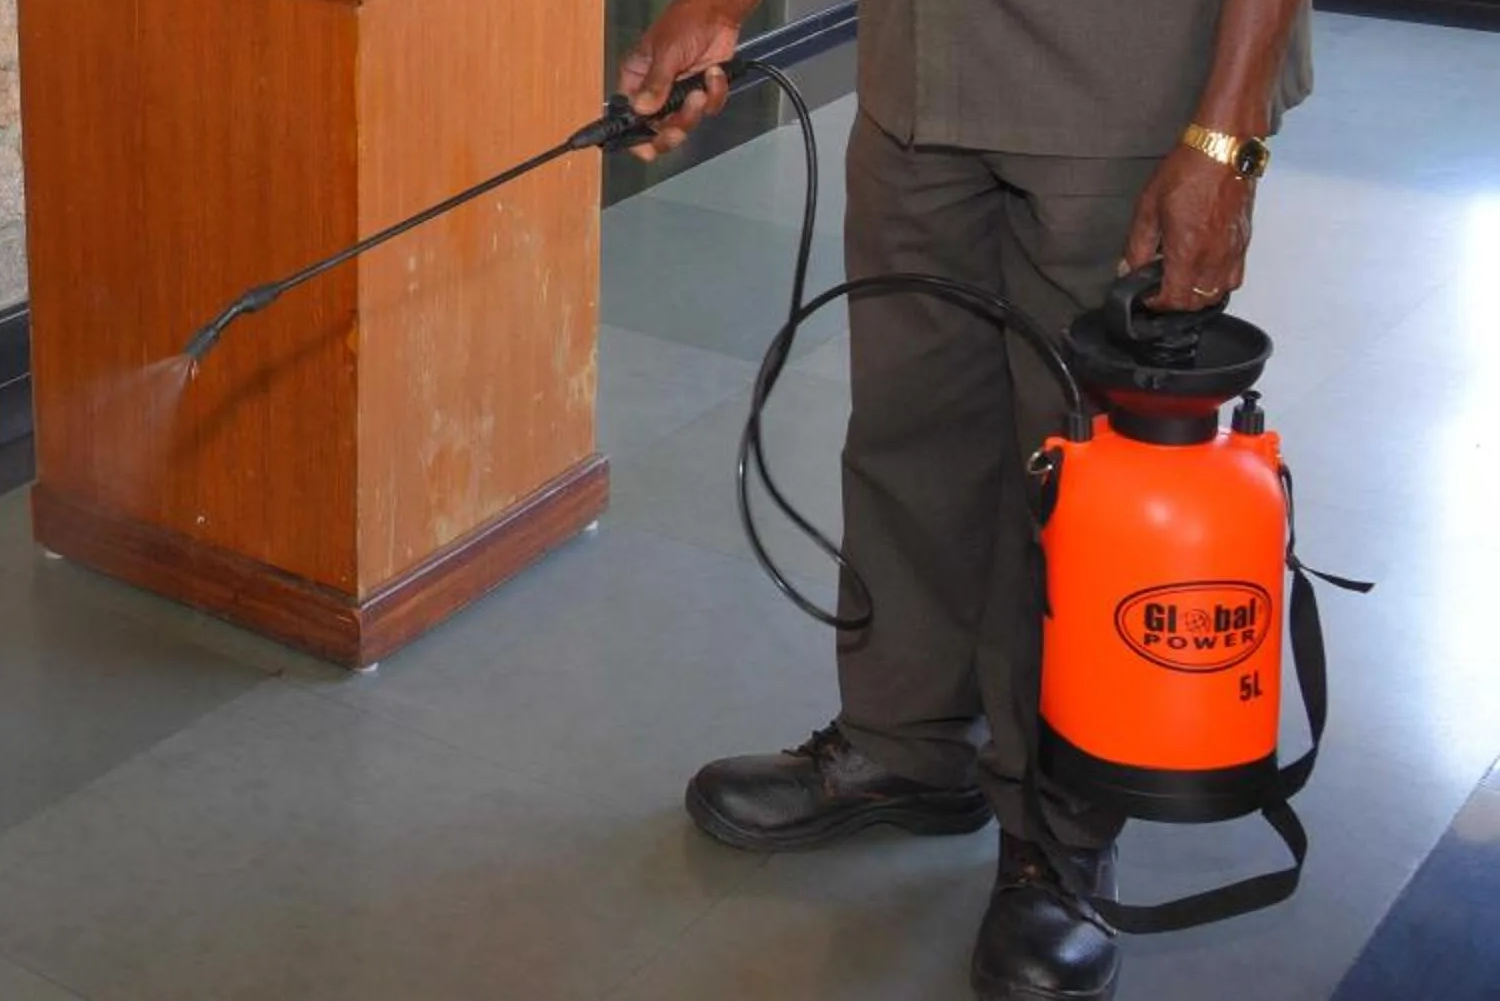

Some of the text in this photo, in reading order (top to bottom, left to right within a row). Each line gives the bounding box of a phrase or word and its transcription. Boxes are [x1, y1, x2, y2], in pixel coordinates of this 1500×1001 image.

[1143, 597, 1257, 634] Global
[1143, 629, 1256, 650] POWER
[1239, 670, 1264, 702] 5L
